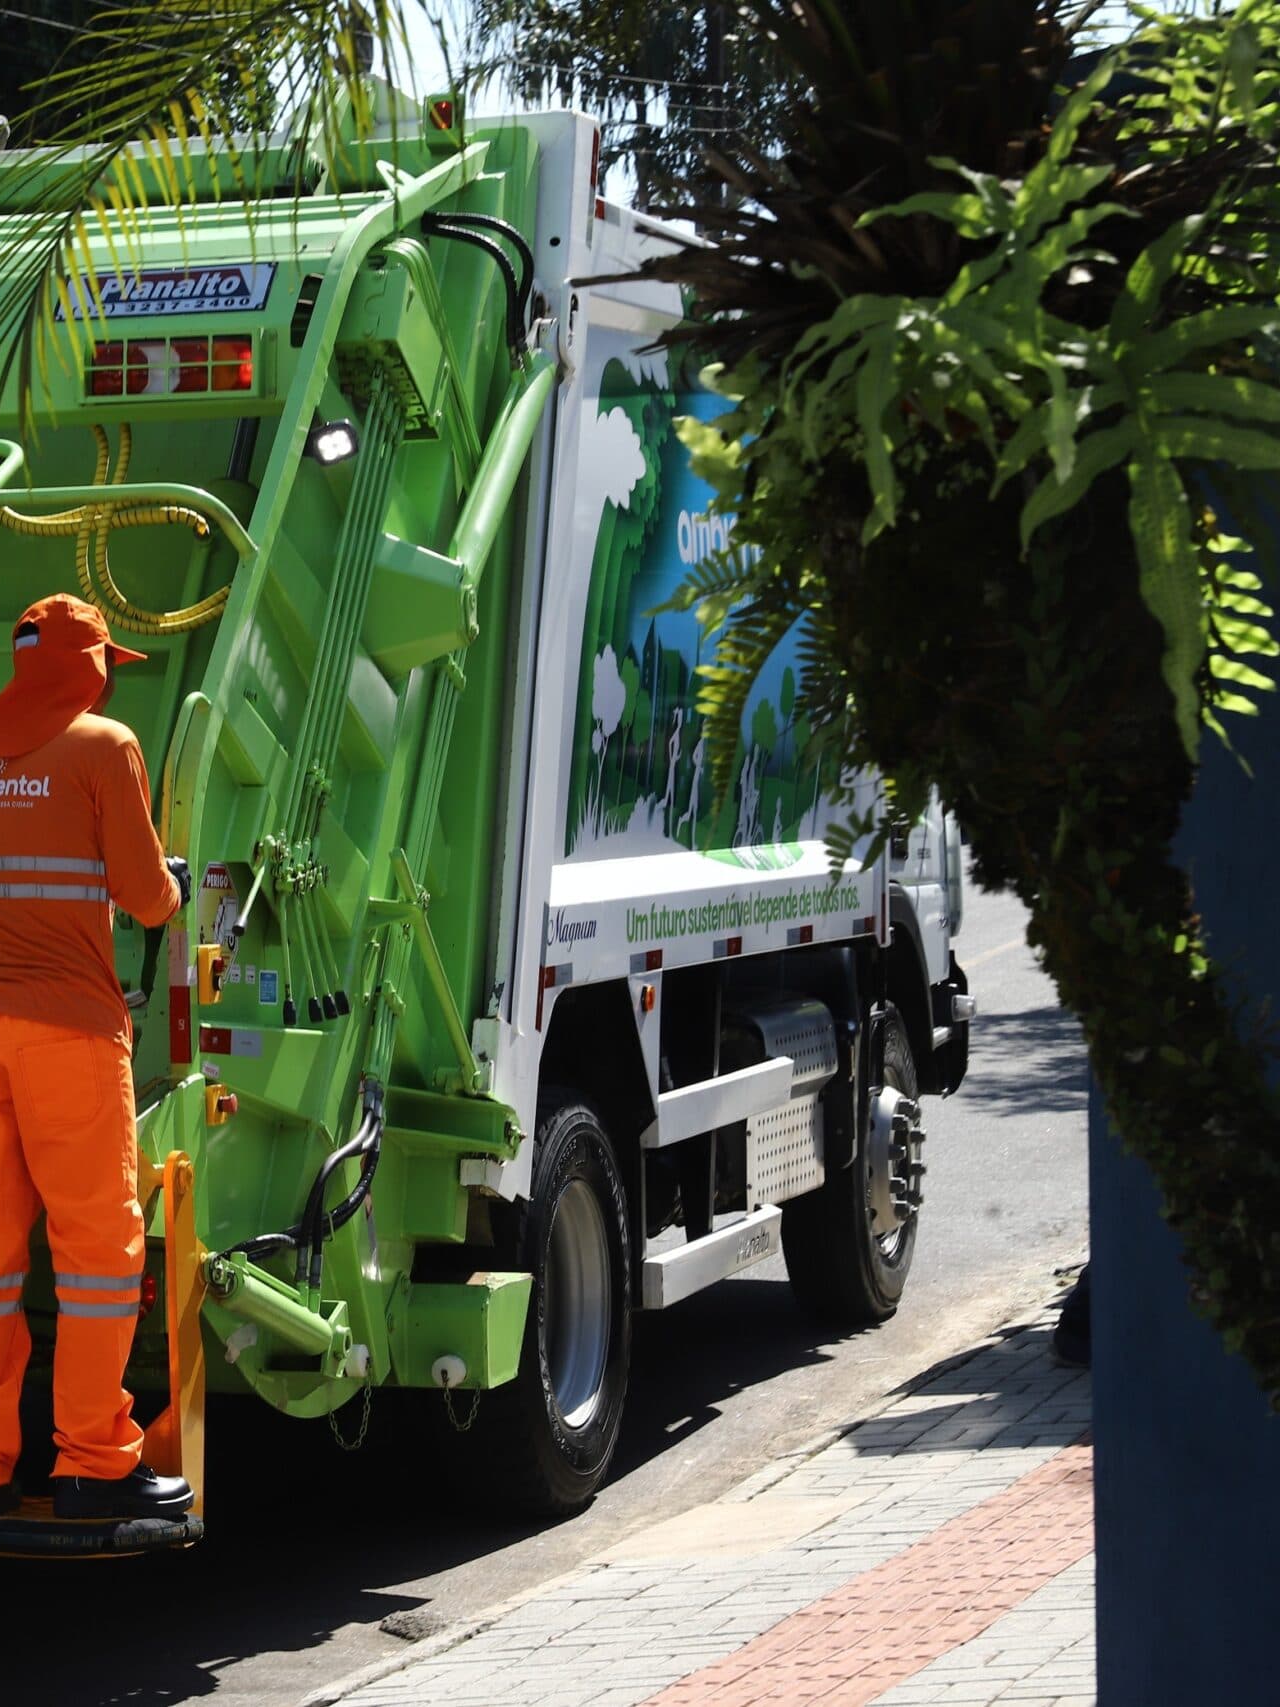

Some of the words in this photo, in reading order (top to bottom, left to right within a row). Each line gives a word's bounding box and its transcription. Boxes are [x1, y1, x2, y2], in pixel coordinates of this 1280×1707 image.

[99, 272, 241, 301] Planalto
[125, 296, 251, 313] 3237-2400
[206, 873, 229, 888] PERIGO
[626, 907, 648, 943] Um
[650, 902, 686, 942] futuro
[688, 892, 752, 935] sustentável
[753, 887, 798, 934] depende
[800, 885, 811, 917] de
[813, 881, 839, 914] todos
[840, 878, 861, 912] nós.
[547, 908, 597, 952] Magnum
